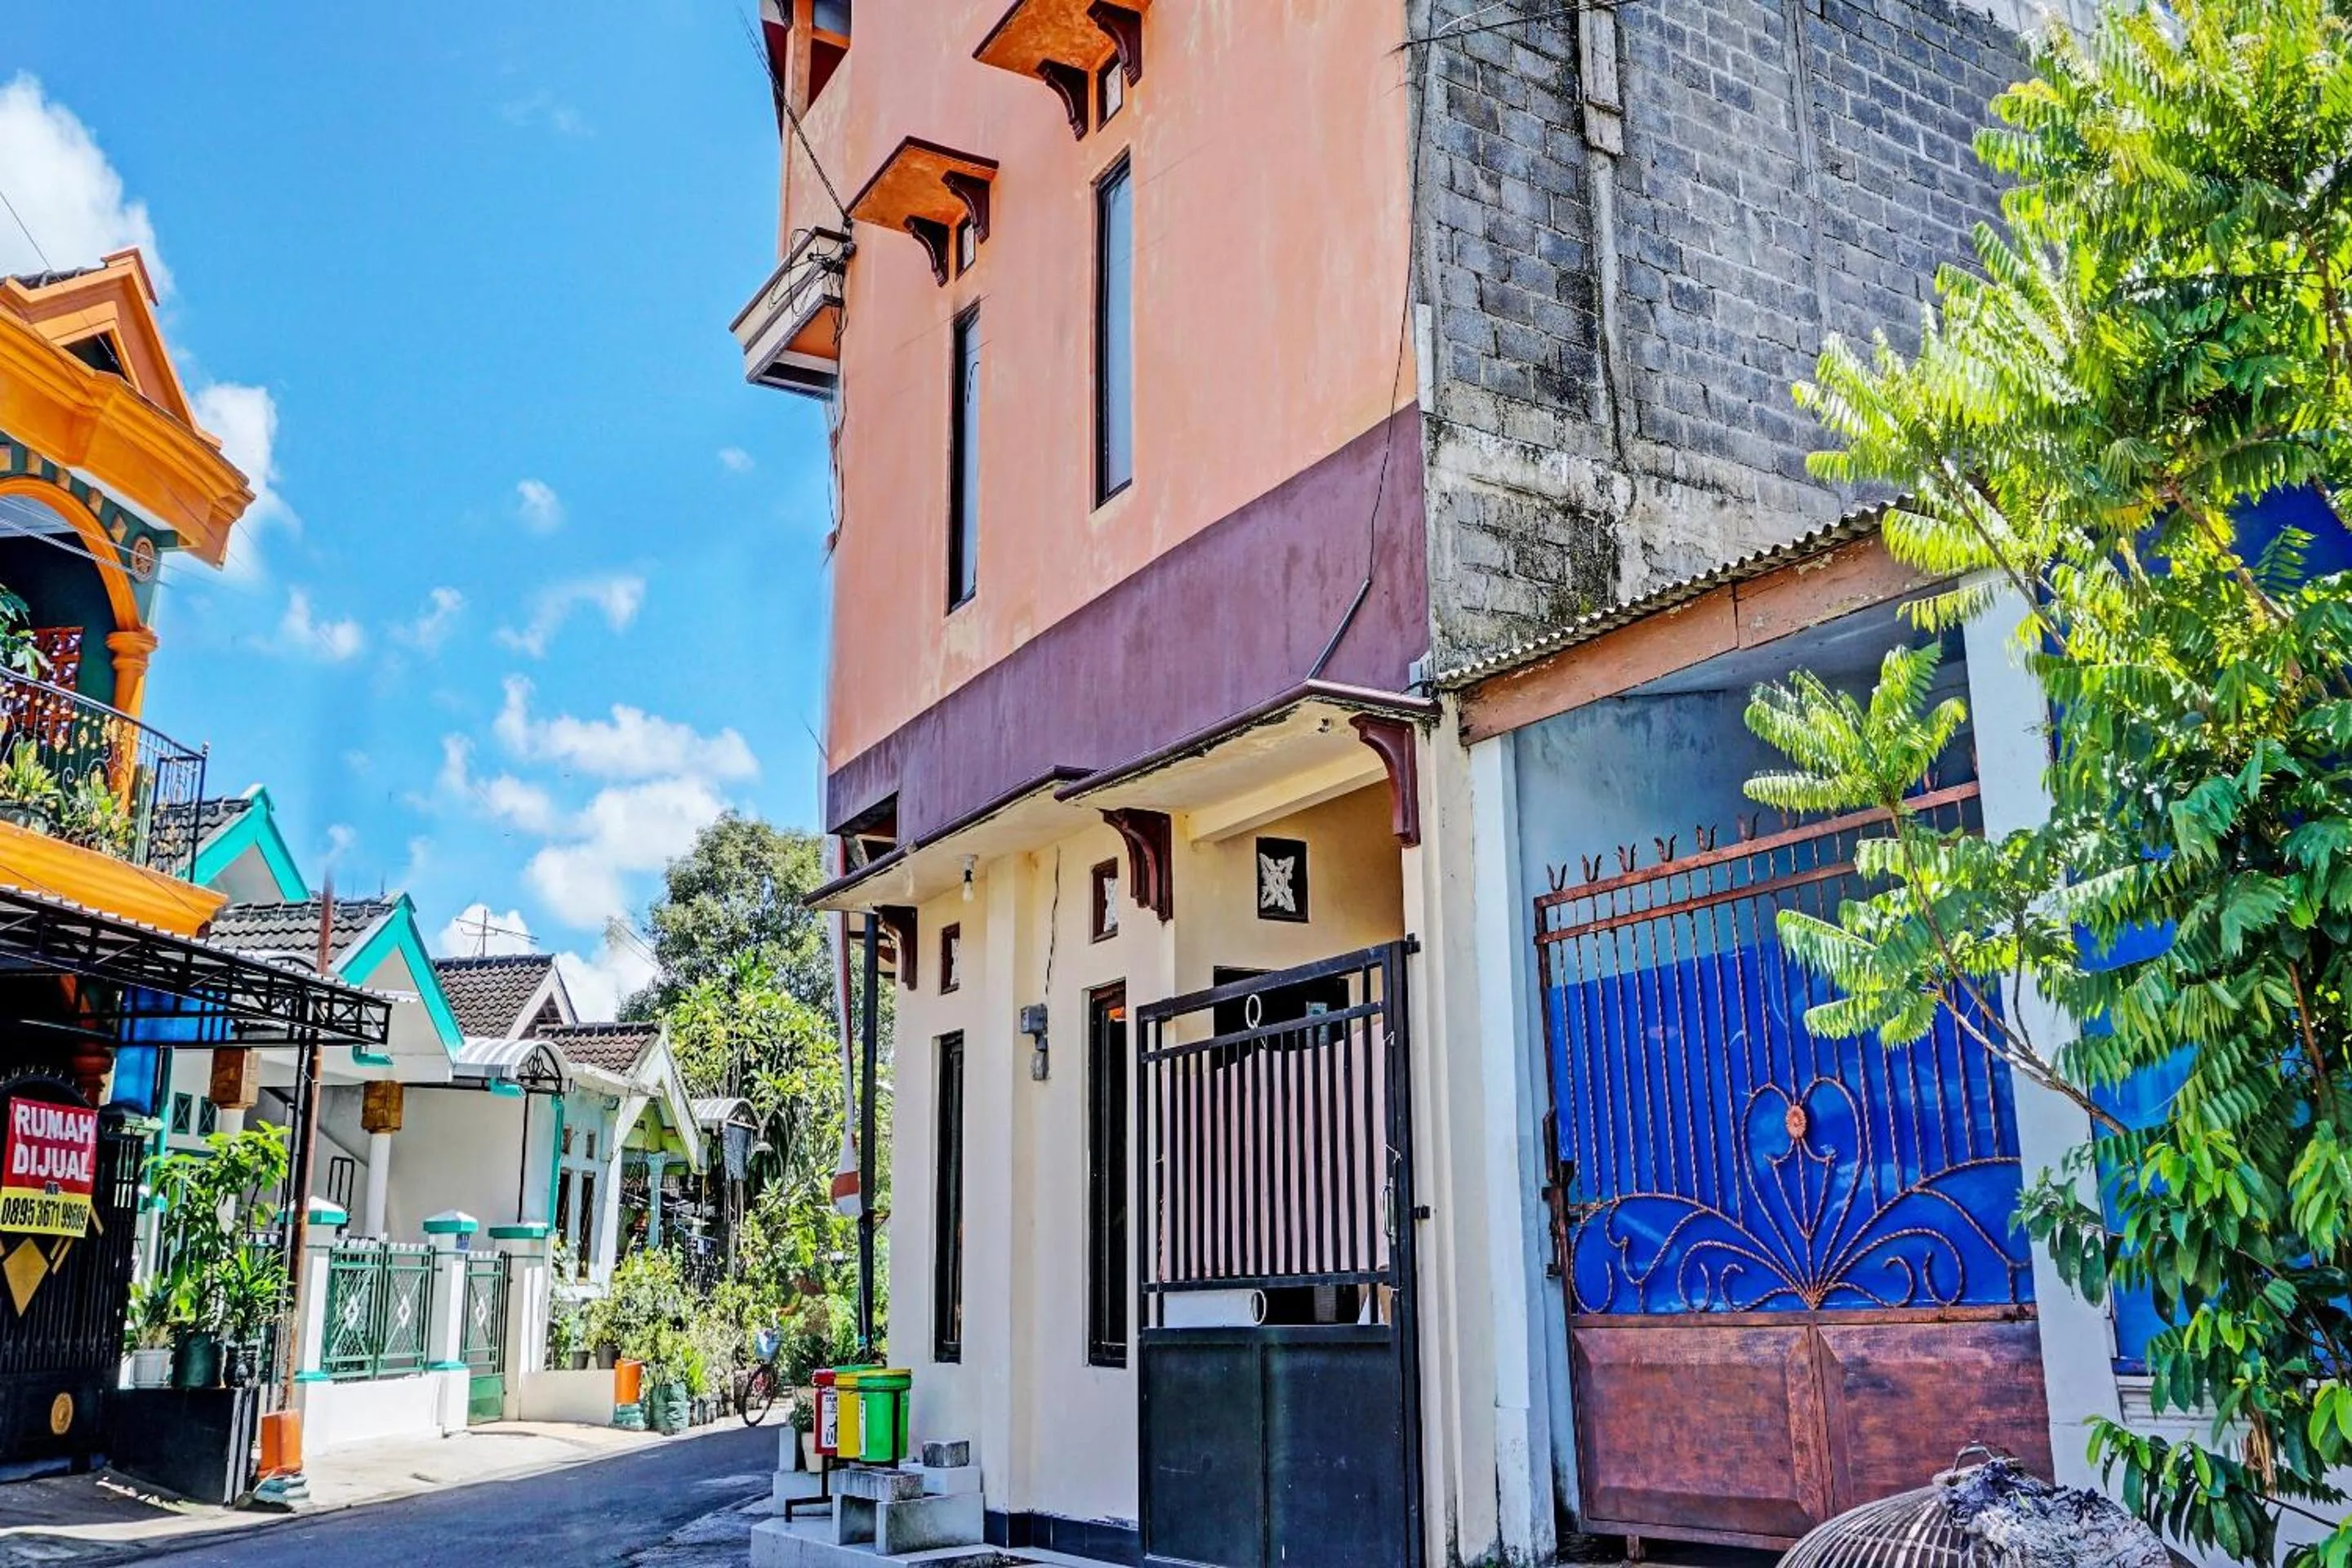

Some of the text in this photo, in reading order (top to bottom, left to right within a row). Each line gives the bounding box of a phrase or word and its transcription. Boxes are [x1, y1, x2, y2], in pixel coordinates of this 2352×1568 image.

[15, 1103, 94, 1143] RUMAH
[12, 1143, 90, 1183] DIJUAL
[1, 1197, 35, 1226] 0895
[35, 1199, 60, 1227] 3671
